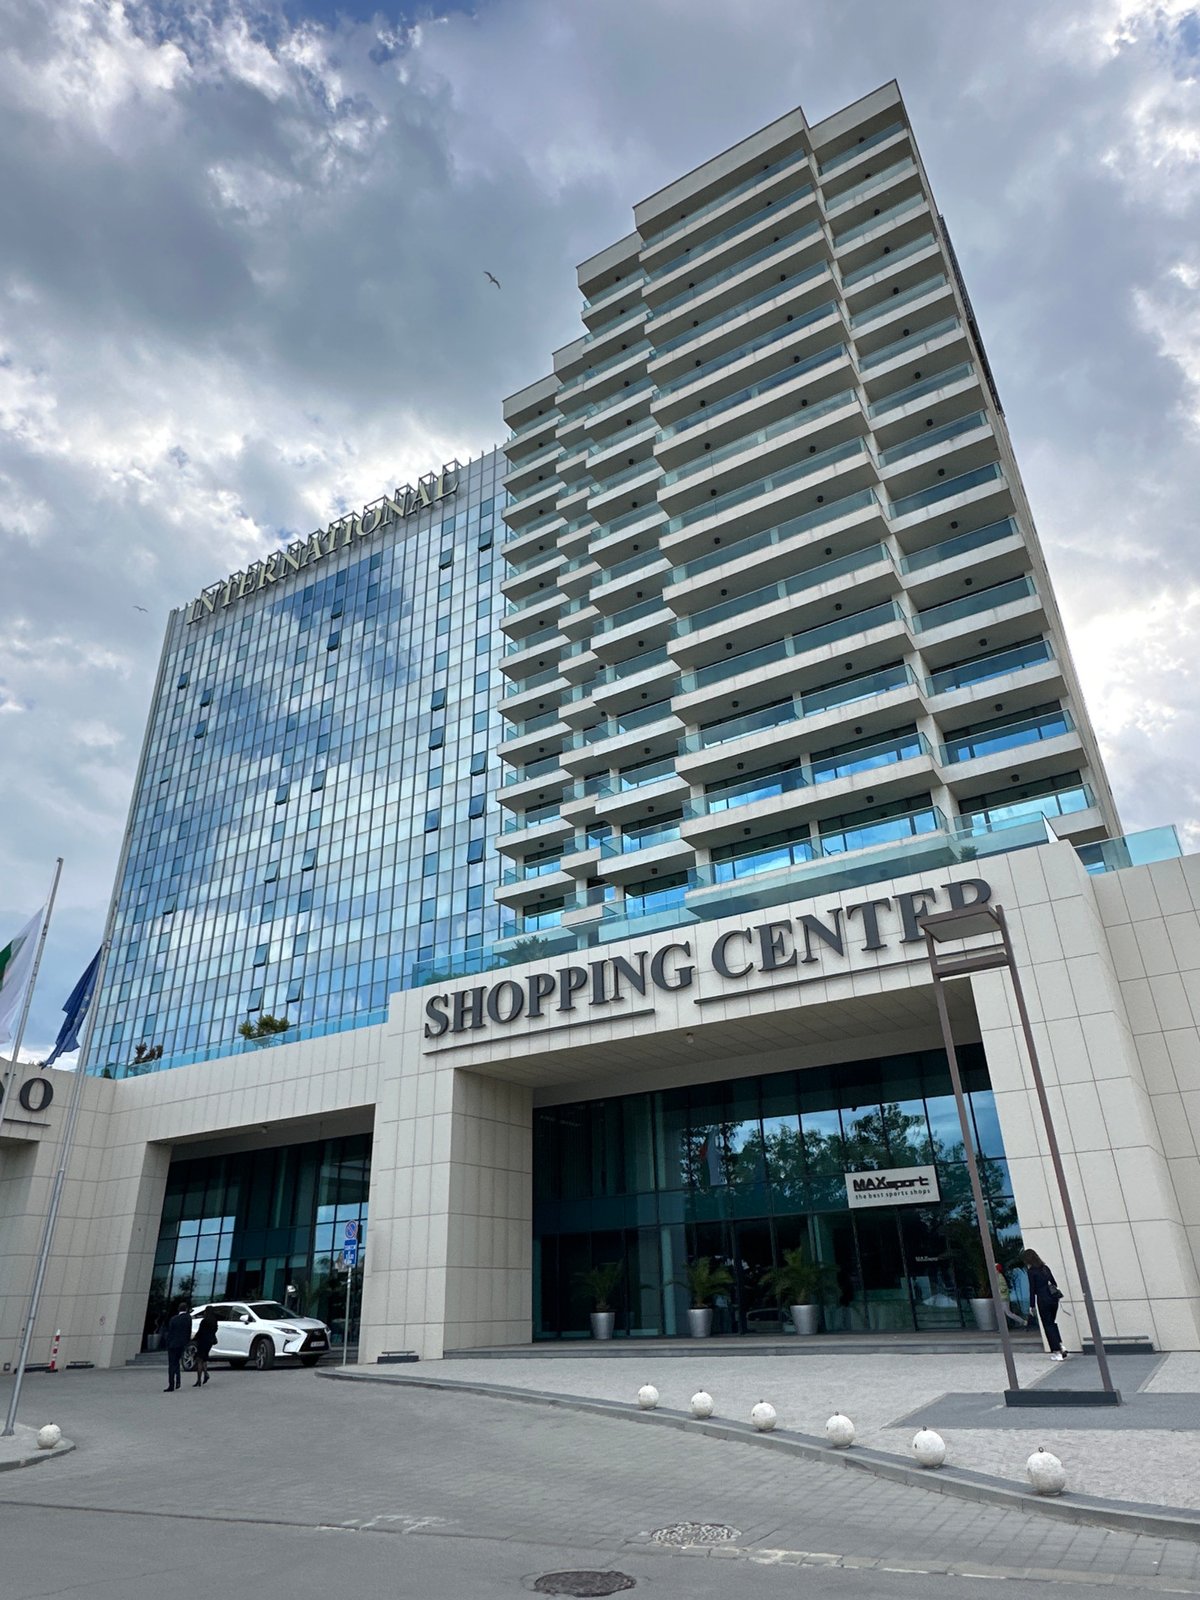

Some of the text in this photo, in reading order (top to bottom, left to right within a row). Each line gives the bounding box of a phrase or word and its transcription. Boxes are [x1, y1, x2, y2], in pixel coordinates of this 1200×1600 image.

[186, 469, 460, 625] INTERNATIONAL
[424, 941, 695, 1039] SHOPPING
[0, 1078, 54, 1112] O
[868, 1192, 884, 1200] best
[885, 1190, 909, 1198] sports
[910, 1188, 931, 1196] shops
